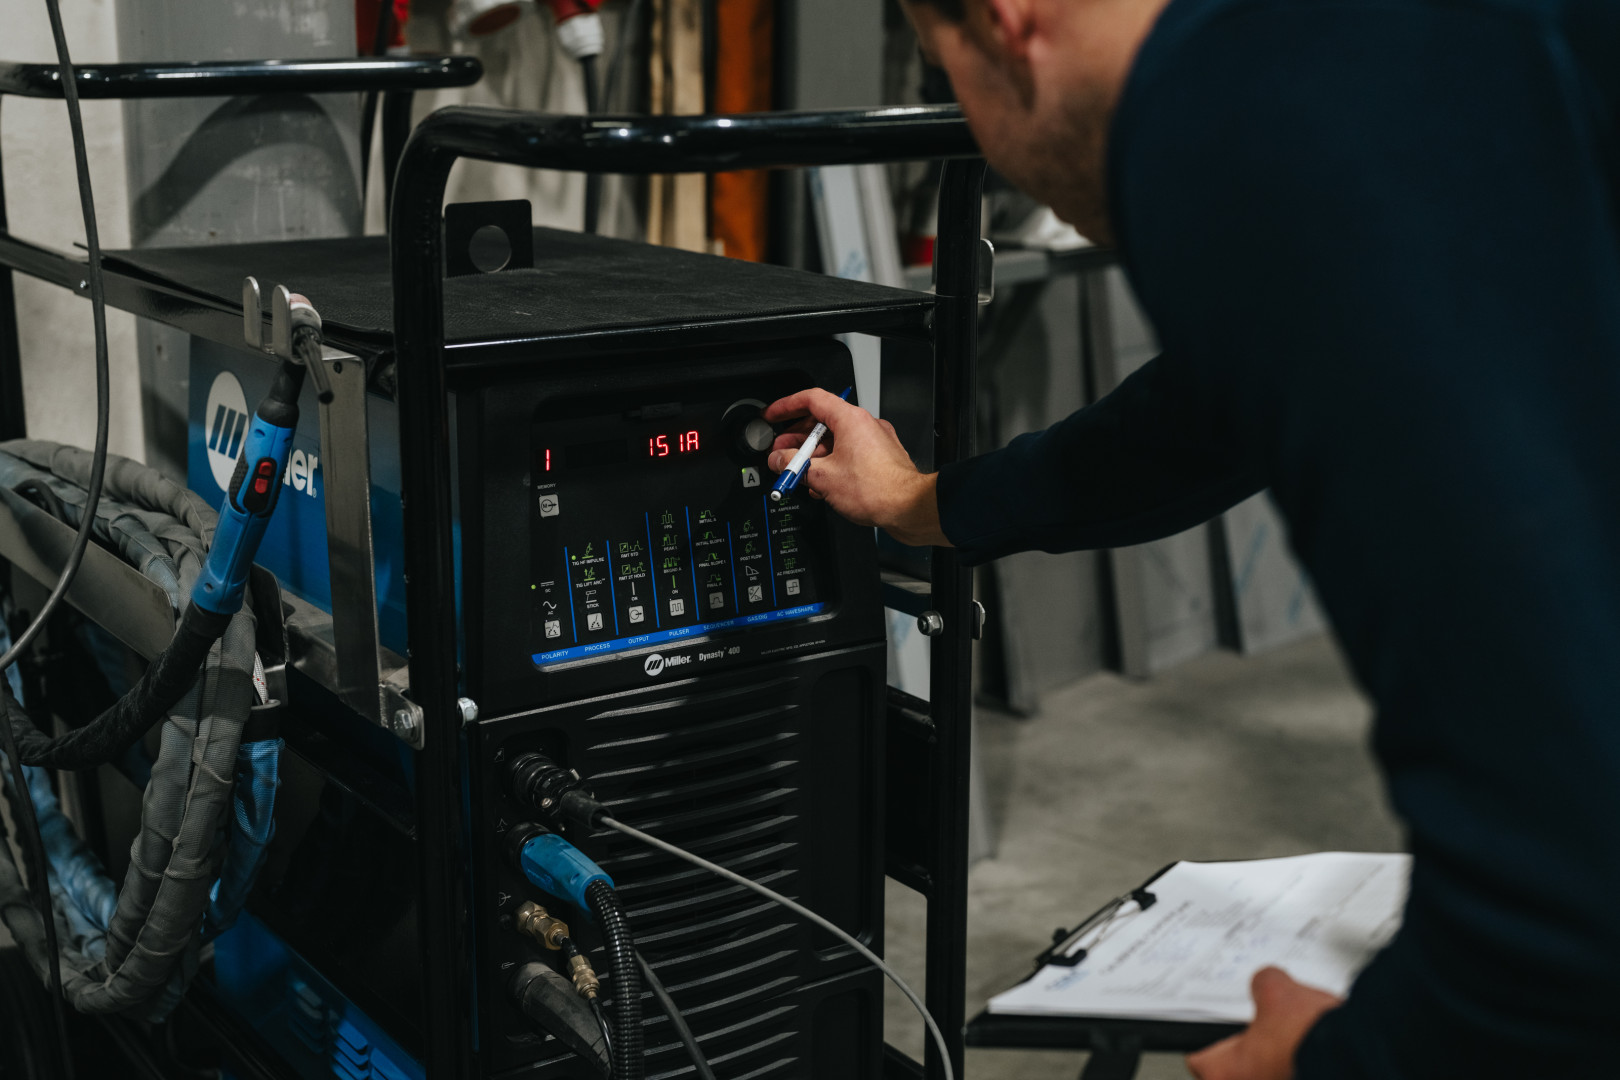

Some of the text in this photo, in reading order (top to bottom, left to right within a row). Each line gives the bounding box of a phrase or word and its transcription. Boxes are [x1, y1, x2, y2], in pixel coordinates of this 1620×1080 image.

[545, 449, 551, 471] 1
[747, 473, 756, 484] A
[778, 504, 800, 512] AMPERAGE
[783, 567, 806, 575] FREQUENCY
[784, 605, 814, 616] WAVESHAPE
[703, 620, 735, 631] SEQUENCER
[668, 628, 690, 637] PULSER
[628, 635, 650, 644] OUTPUT
[584, 643, 611, 652] PROCESS
[728, 646, 741, 655] 400
[541, 650, 569, 660] POLARITY
